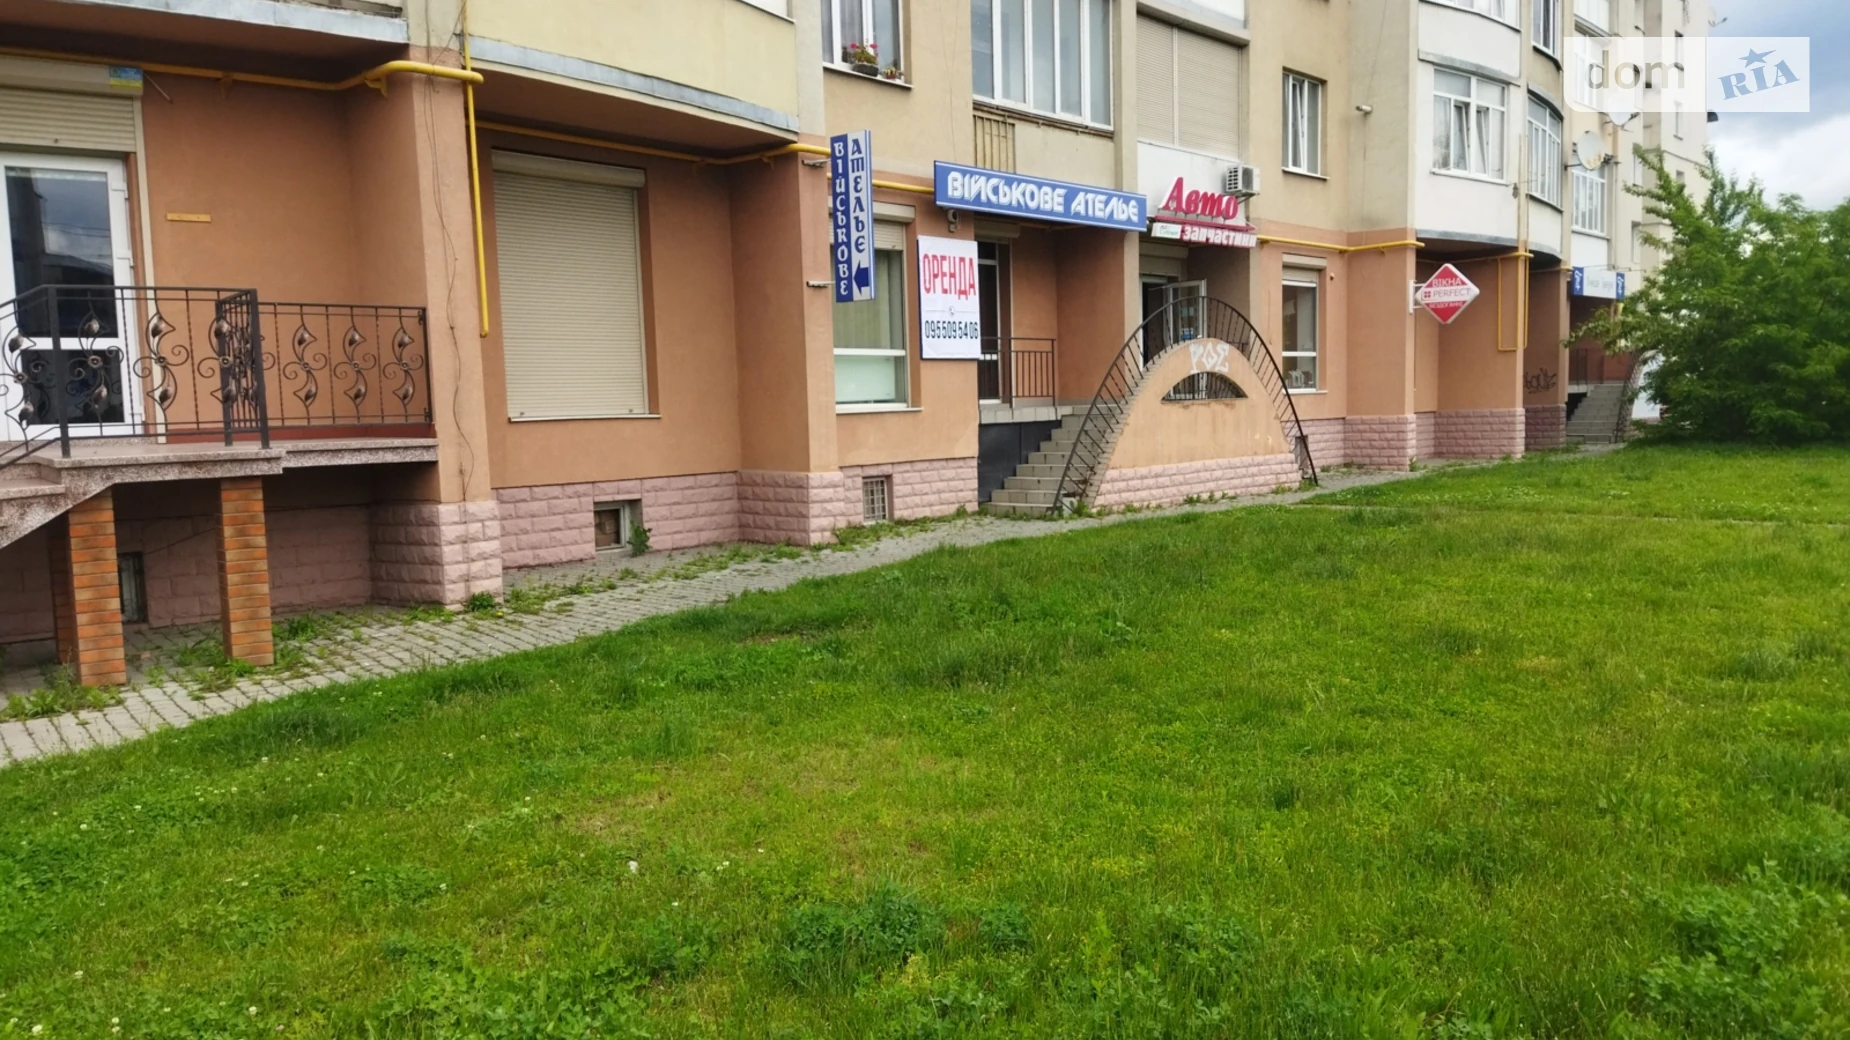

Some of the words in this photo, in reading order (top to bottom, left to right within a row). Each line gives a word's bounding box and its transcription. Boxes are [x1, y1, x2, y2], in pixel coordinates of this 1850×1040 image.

[834, 142, 849, 296] ВІЙСЬКОВЕ
[947, 171, 1067, 213] ВІЙСЬКОВЕ
[1070, 191, 1139, 223] АТЕЛЬЄ
[1162, 176, 1238, 220] Авто
[922, 253, 976, 300] ОРЕНДА
[1433, 288, 1471, 297] PERFECT
